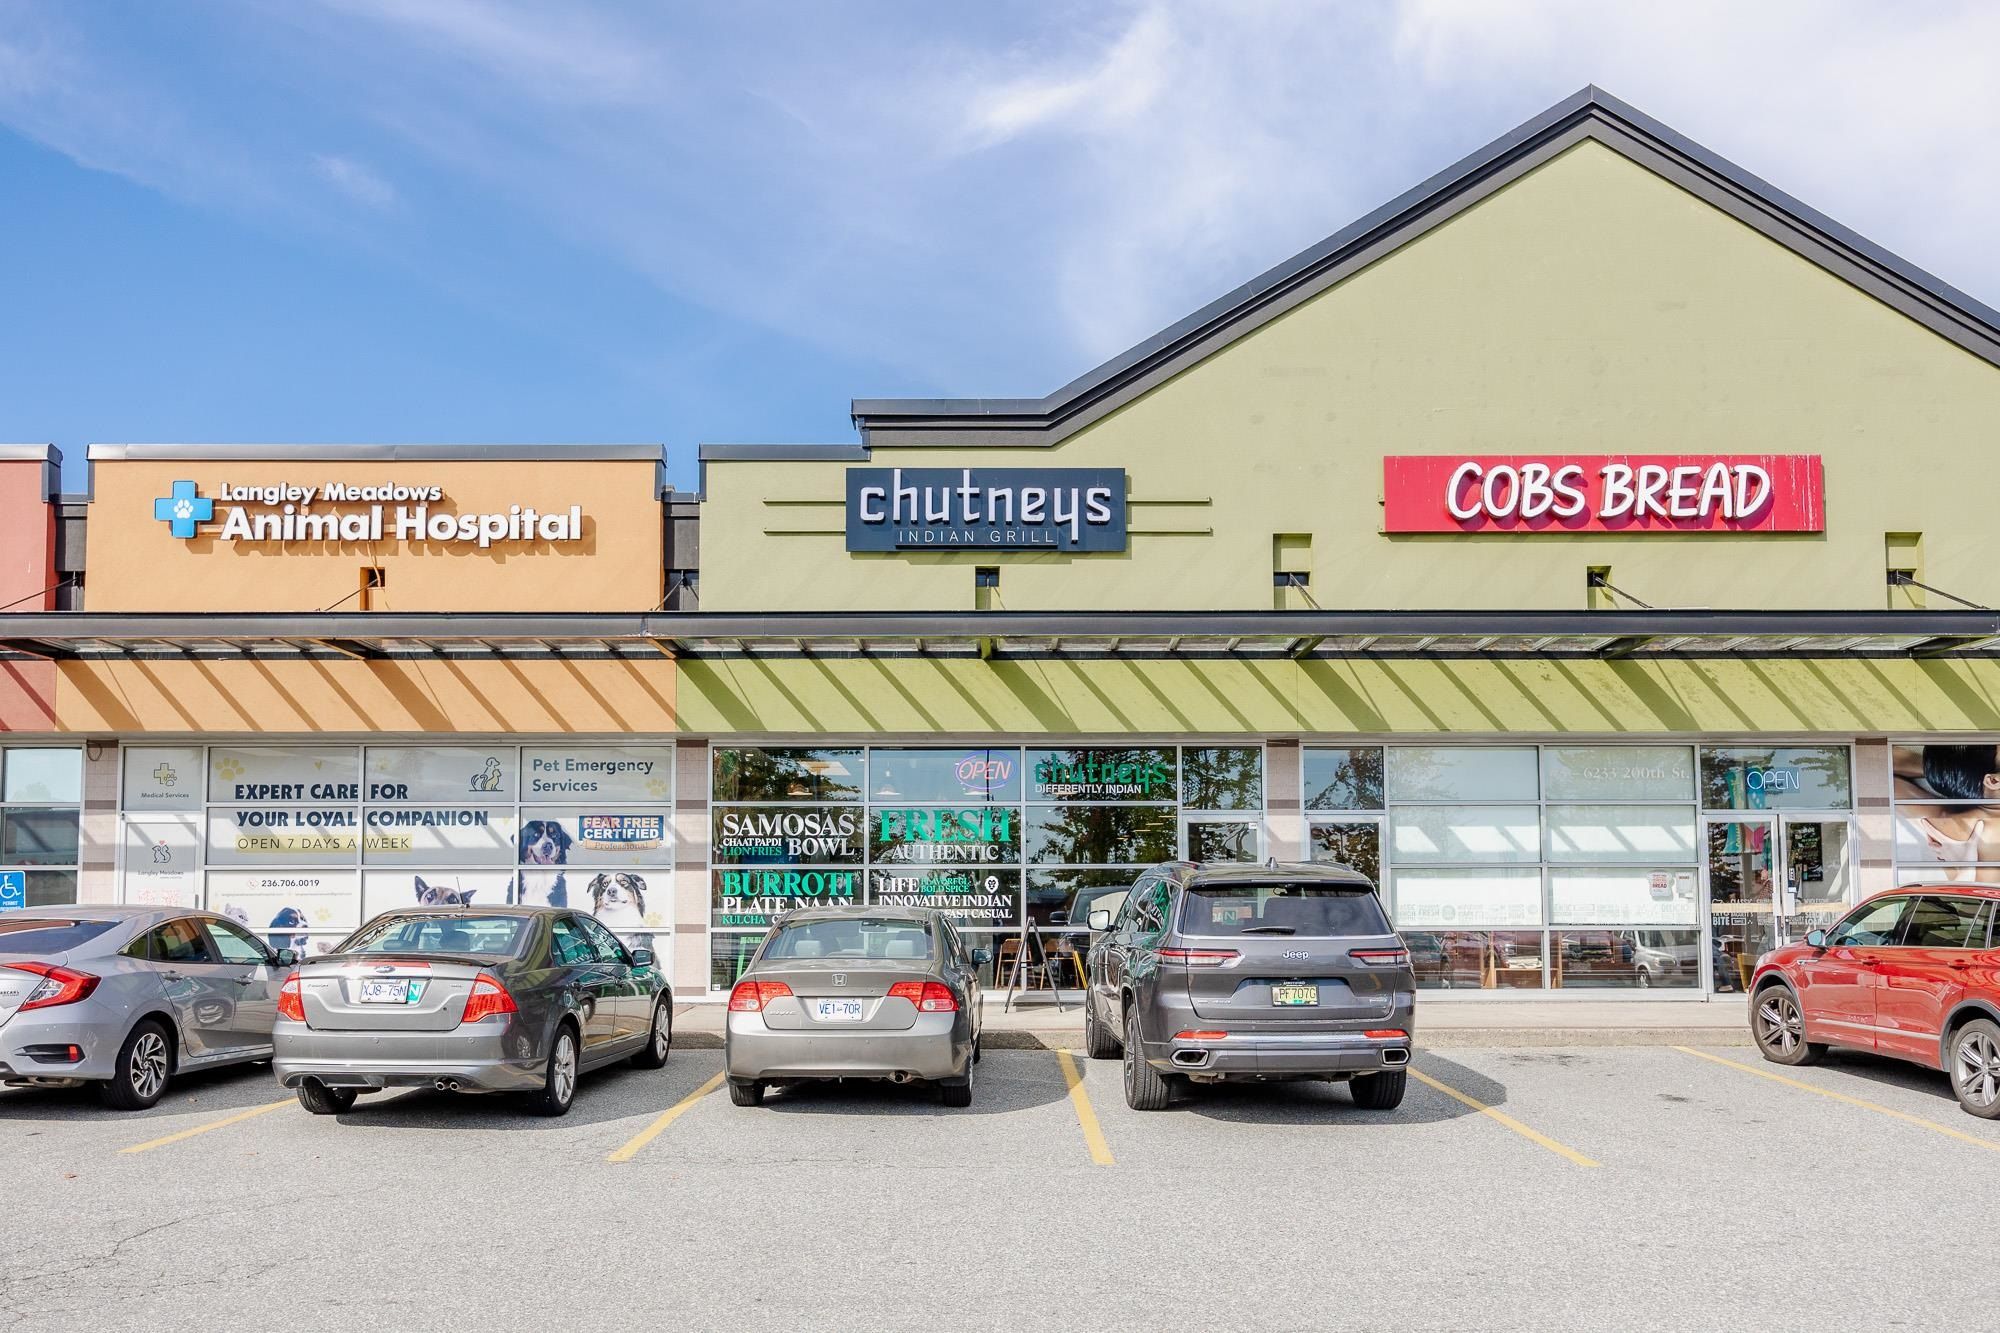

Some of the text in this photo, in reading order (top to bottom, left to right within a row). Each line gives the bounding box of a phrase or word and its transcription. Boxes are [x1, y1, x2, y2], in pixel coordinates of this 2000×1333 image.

[220, 482, 442, 506] Langley Meadows
[1446, 461, 1771, 519] COBS BREAD
[860, 469, 1112, 542] chutneys
[220, 504, 582, 548] Animal Hospital
[899, 530, 1053, 543] INDIAN GRILL
[532, 758, 654, 775] Pet Emergency
[958, 760, 1012, 780] OPEN
[1035, 752, 1167, 794] chutneys
[532, 778, 598, 793] Services
[1746, 770, 1800, 790] OPEN
[234, 783, 409, 800] EXPERT CARE FOR
[1035, 784, 1142, 794] DIFFERENTLY INDIAN
[236, 811, 489, 827] YOUR LOYAL COMPANION
[583, 817, 659, 829] FEAR FREE
[722, 813, 856, 837] SAMOSAS
[879, 810, 1013, 842] FRESH
[583, 828, 660, 839] CERTIFIED
[237, 837, 410, 849] OPEN 7 DAYS A WEEK
[594, 841, 649, 850] Professional
[786, 838, 855, 856] BOWL
[750, 847, 782, 856] FRIES
[892, 844, 999, 861] AUTHENTIC
[261, 879, 320, 888] 236.706.0019
[722, 872, 854, 896] BURROTI
[878, 877, 919, 893] LIFE
[920, 885, 970, 893] BOLD SPICE
[722, 896, 788, 915] PLATE
[878, 894, 1013, 907] INNOVATIVE INDIAN
[722, 915, 766, 925] KULCHA
[970, 908, 1013, 919] CASUAL
[1282, 950, 1309, 960] Jeep
[410, 984, 420, 994] N
